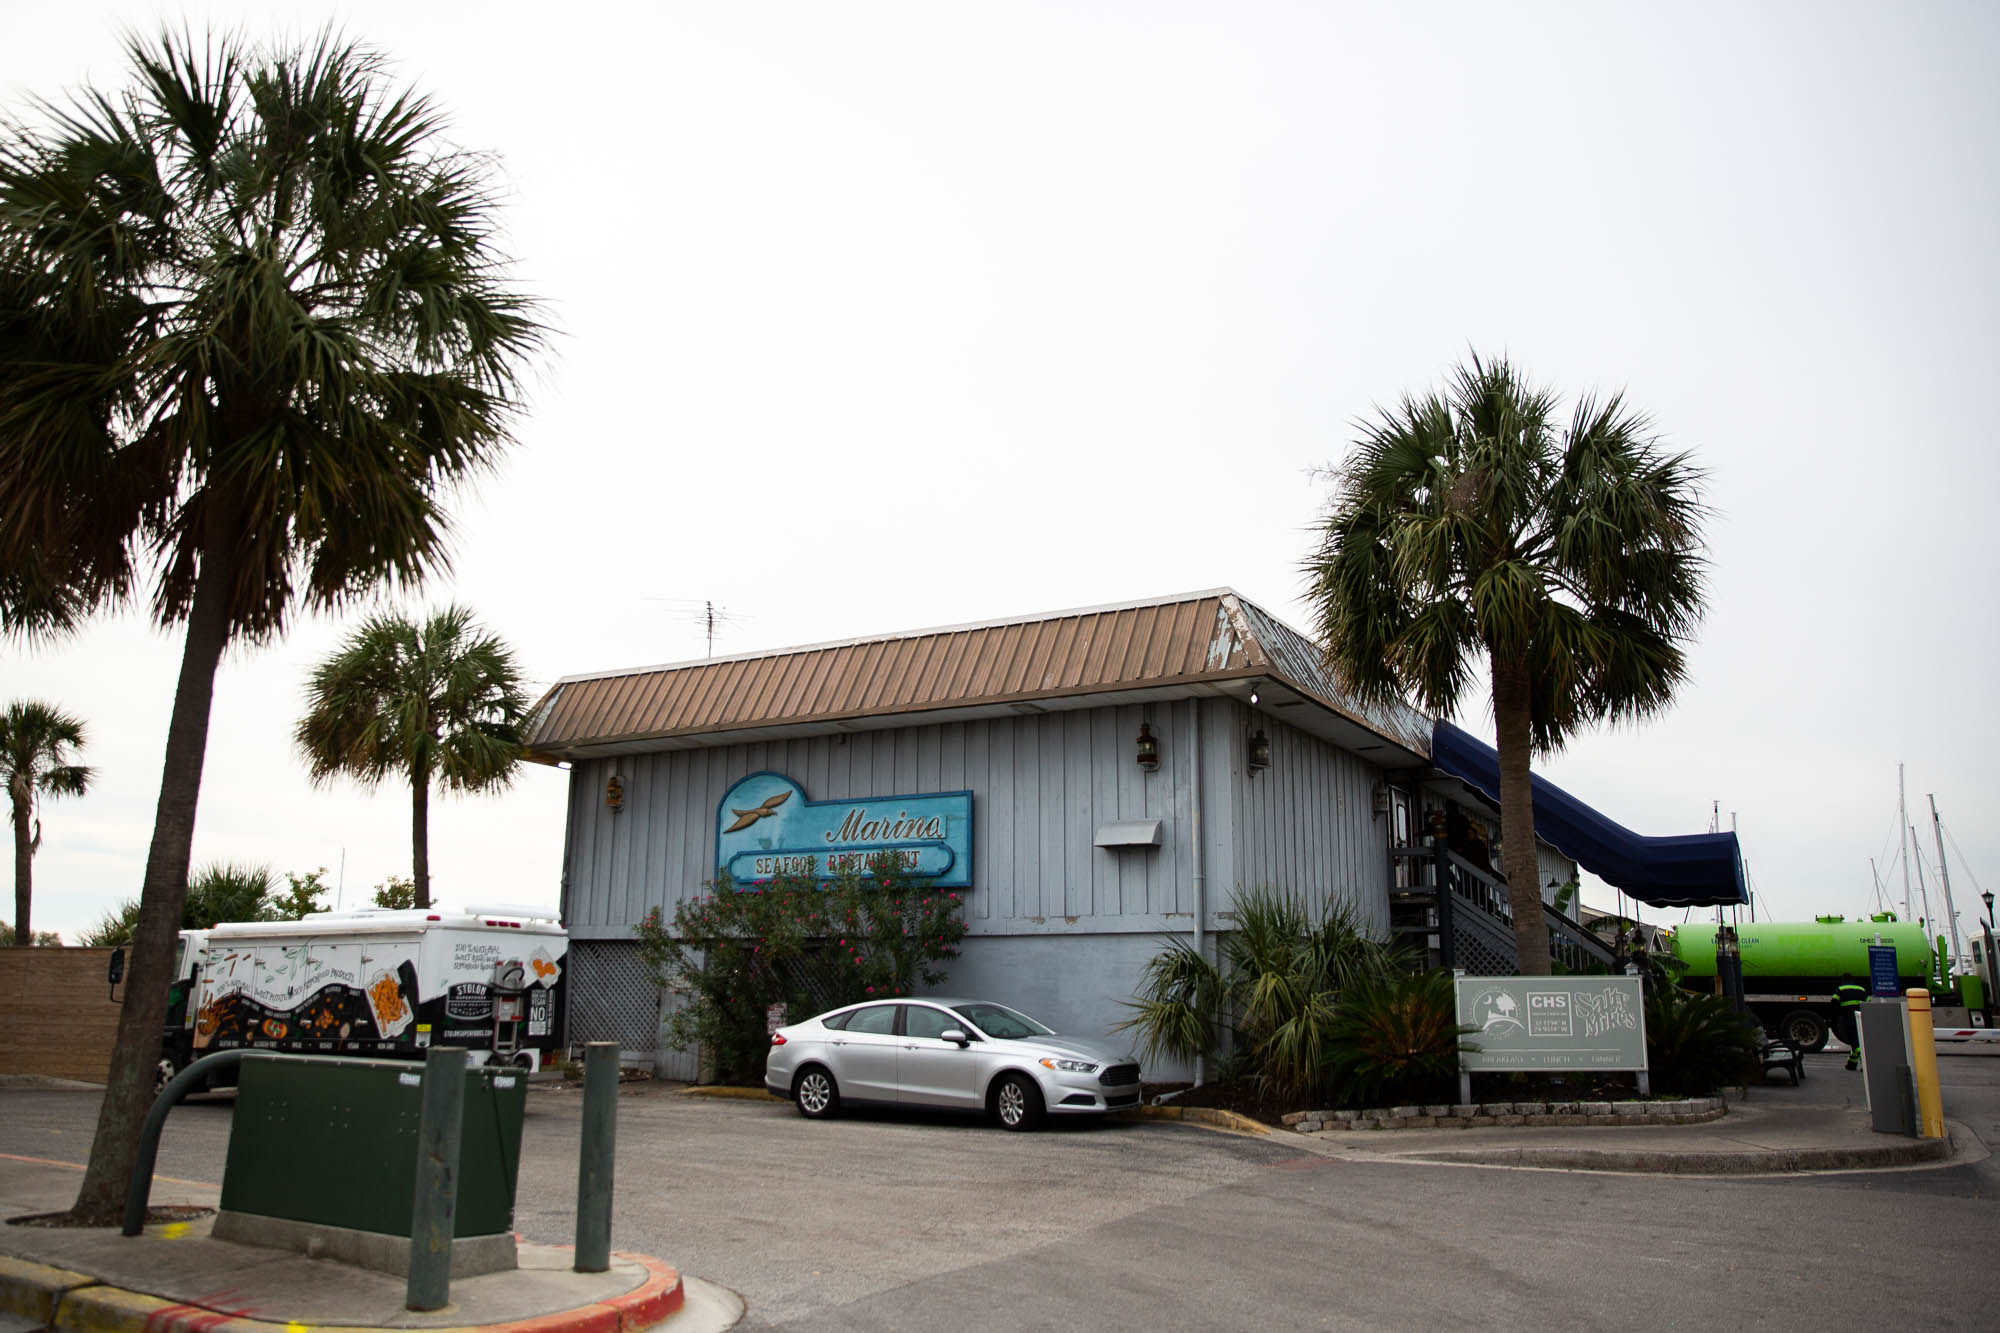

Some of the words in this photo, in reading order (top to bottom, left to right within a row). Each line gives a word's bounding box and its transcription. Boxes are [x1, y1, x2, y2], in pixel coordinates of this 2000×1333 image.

[825, 807, 942, 842] Marina
[755, 855, 816, 875] SEAFOOD
[456, 983, 487, 995] STOLON
[1531, 995, 1566, 1008] CHS
[529, 1006, 546, 1021] NO
